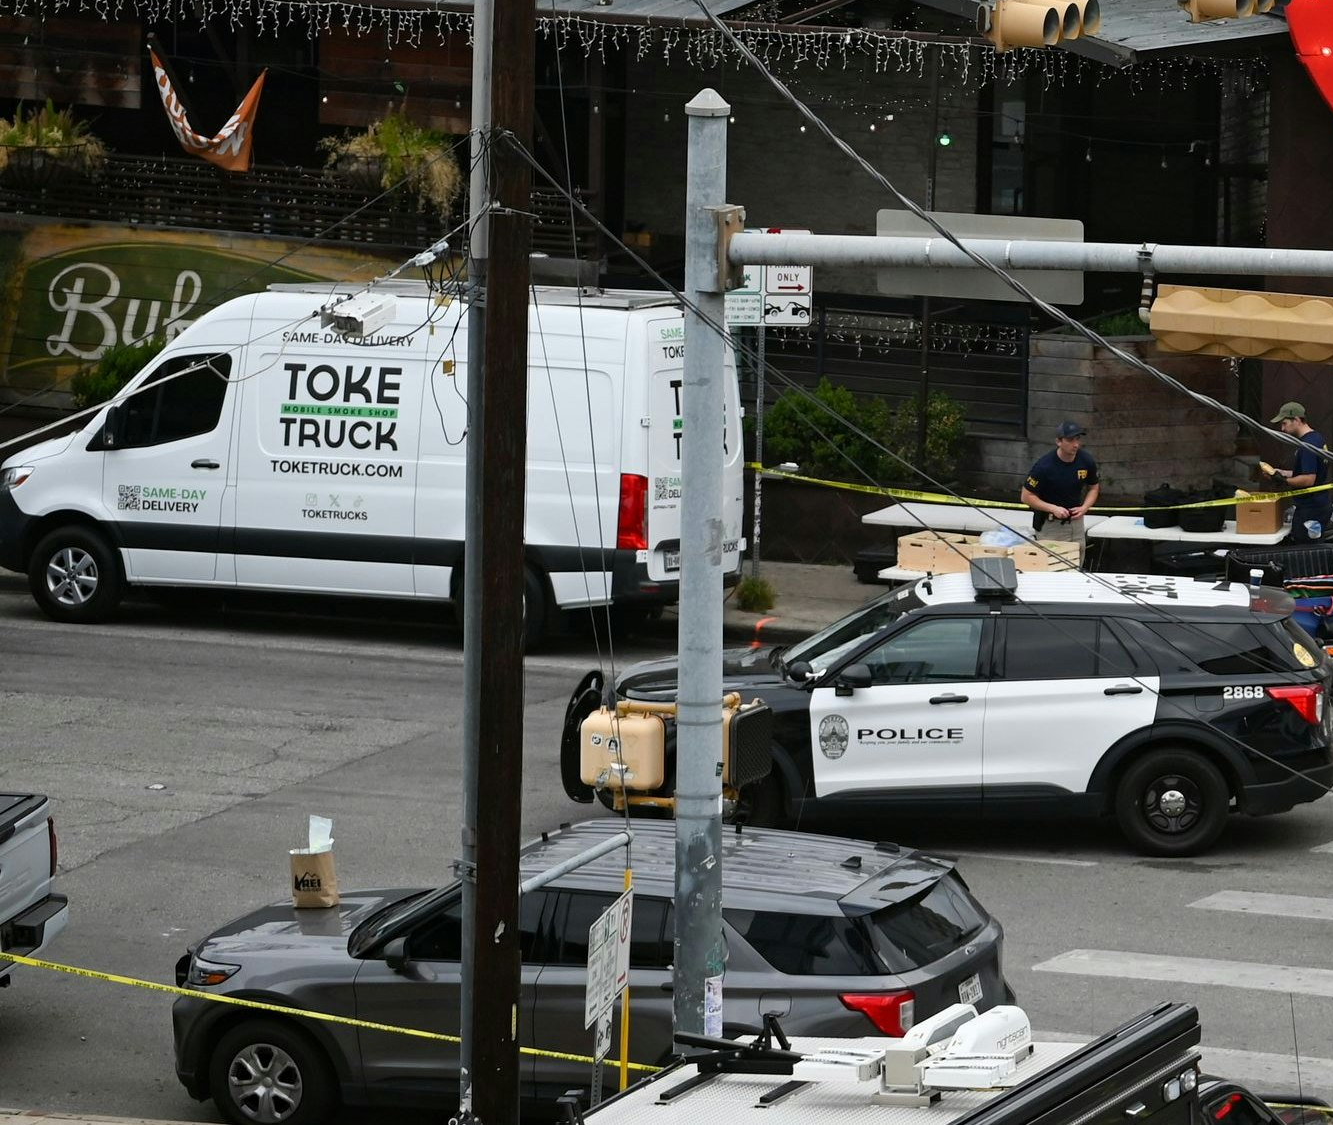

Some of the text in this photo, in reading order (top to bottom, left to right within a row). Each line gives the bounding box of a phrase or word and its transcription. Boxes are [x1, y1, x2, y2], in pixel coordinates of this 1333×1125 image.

[777, 273, 800, 282] ONLY
[282, 331, 414, 348] SAME-DAY DELIVERY
[284, 363, 402, 404] TOKE
[283, 405, 396, 418] MOBILE SMOKE SHOP
[279, 418, 398, 451] TRUCK
[271, 460, 402, 477] TOKETRUCK.COM
[142, 487, 207, 500] SAME-DAY
[142, 500, 199, 513] DELIVERY
[302, 509, 368, 520] TOKETRUCKS
[1223, 686, 1264, 699] 2868
[858, 728, 964, 740] POLICE
[303, 878, 321, 888] REI
